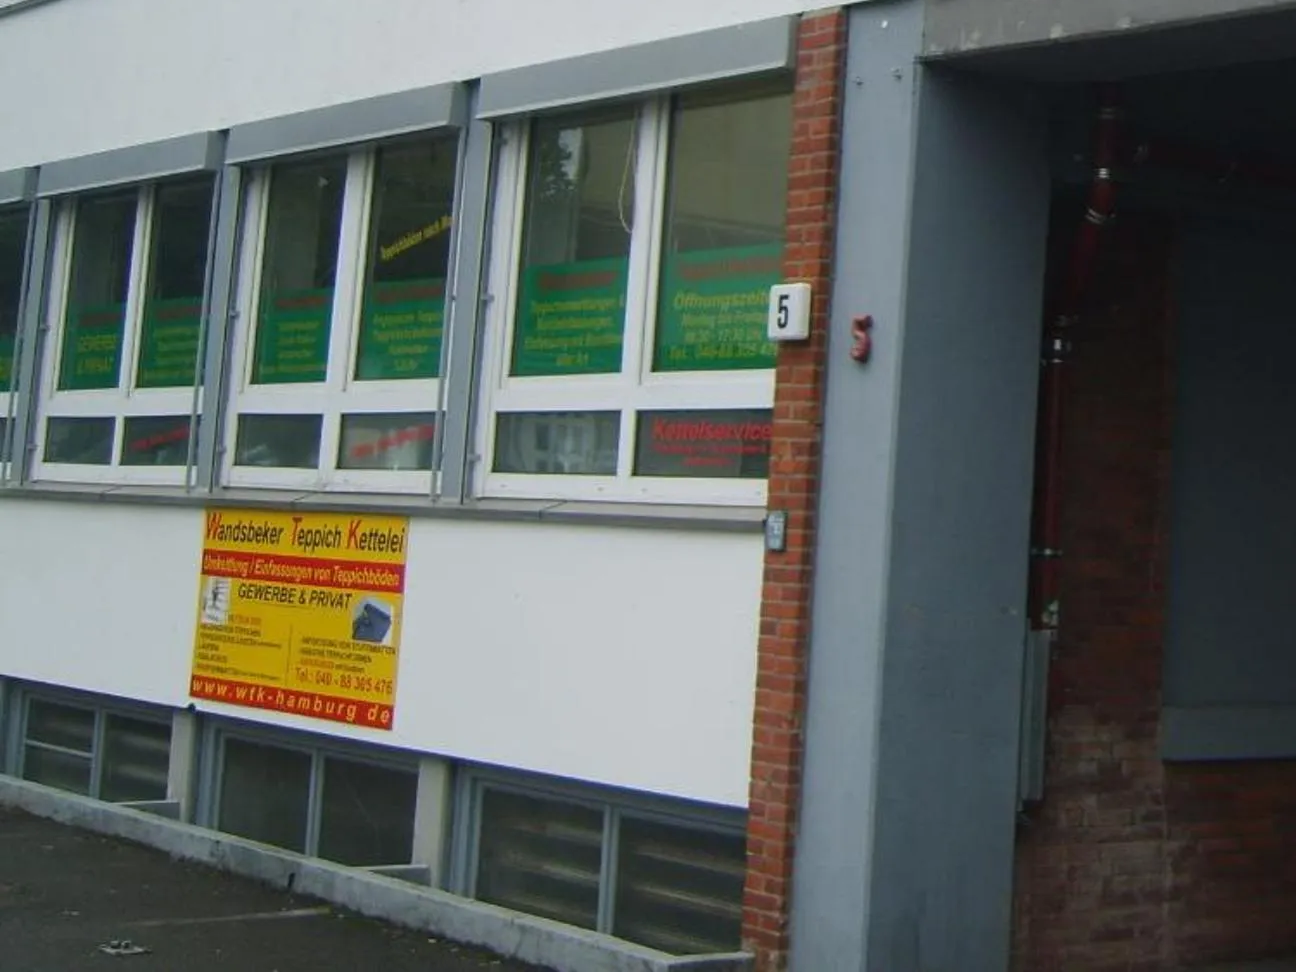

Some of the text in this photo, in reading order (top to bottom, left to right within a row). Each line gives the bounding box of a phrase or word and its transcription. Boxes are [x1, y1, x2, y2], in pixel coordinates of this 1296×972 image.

[777, 294, 790, 329] 5
[206, 513, 405, 554] Wandsbeker Teppich Kettelei
[314, 567, 331, 581] von
[332, 565, 400, 587] Teppichböden
[238, 583, 353, 610] GEWERBE & PRIVAT
[192, 678, 391, 725] www.wtk-hamburgde
